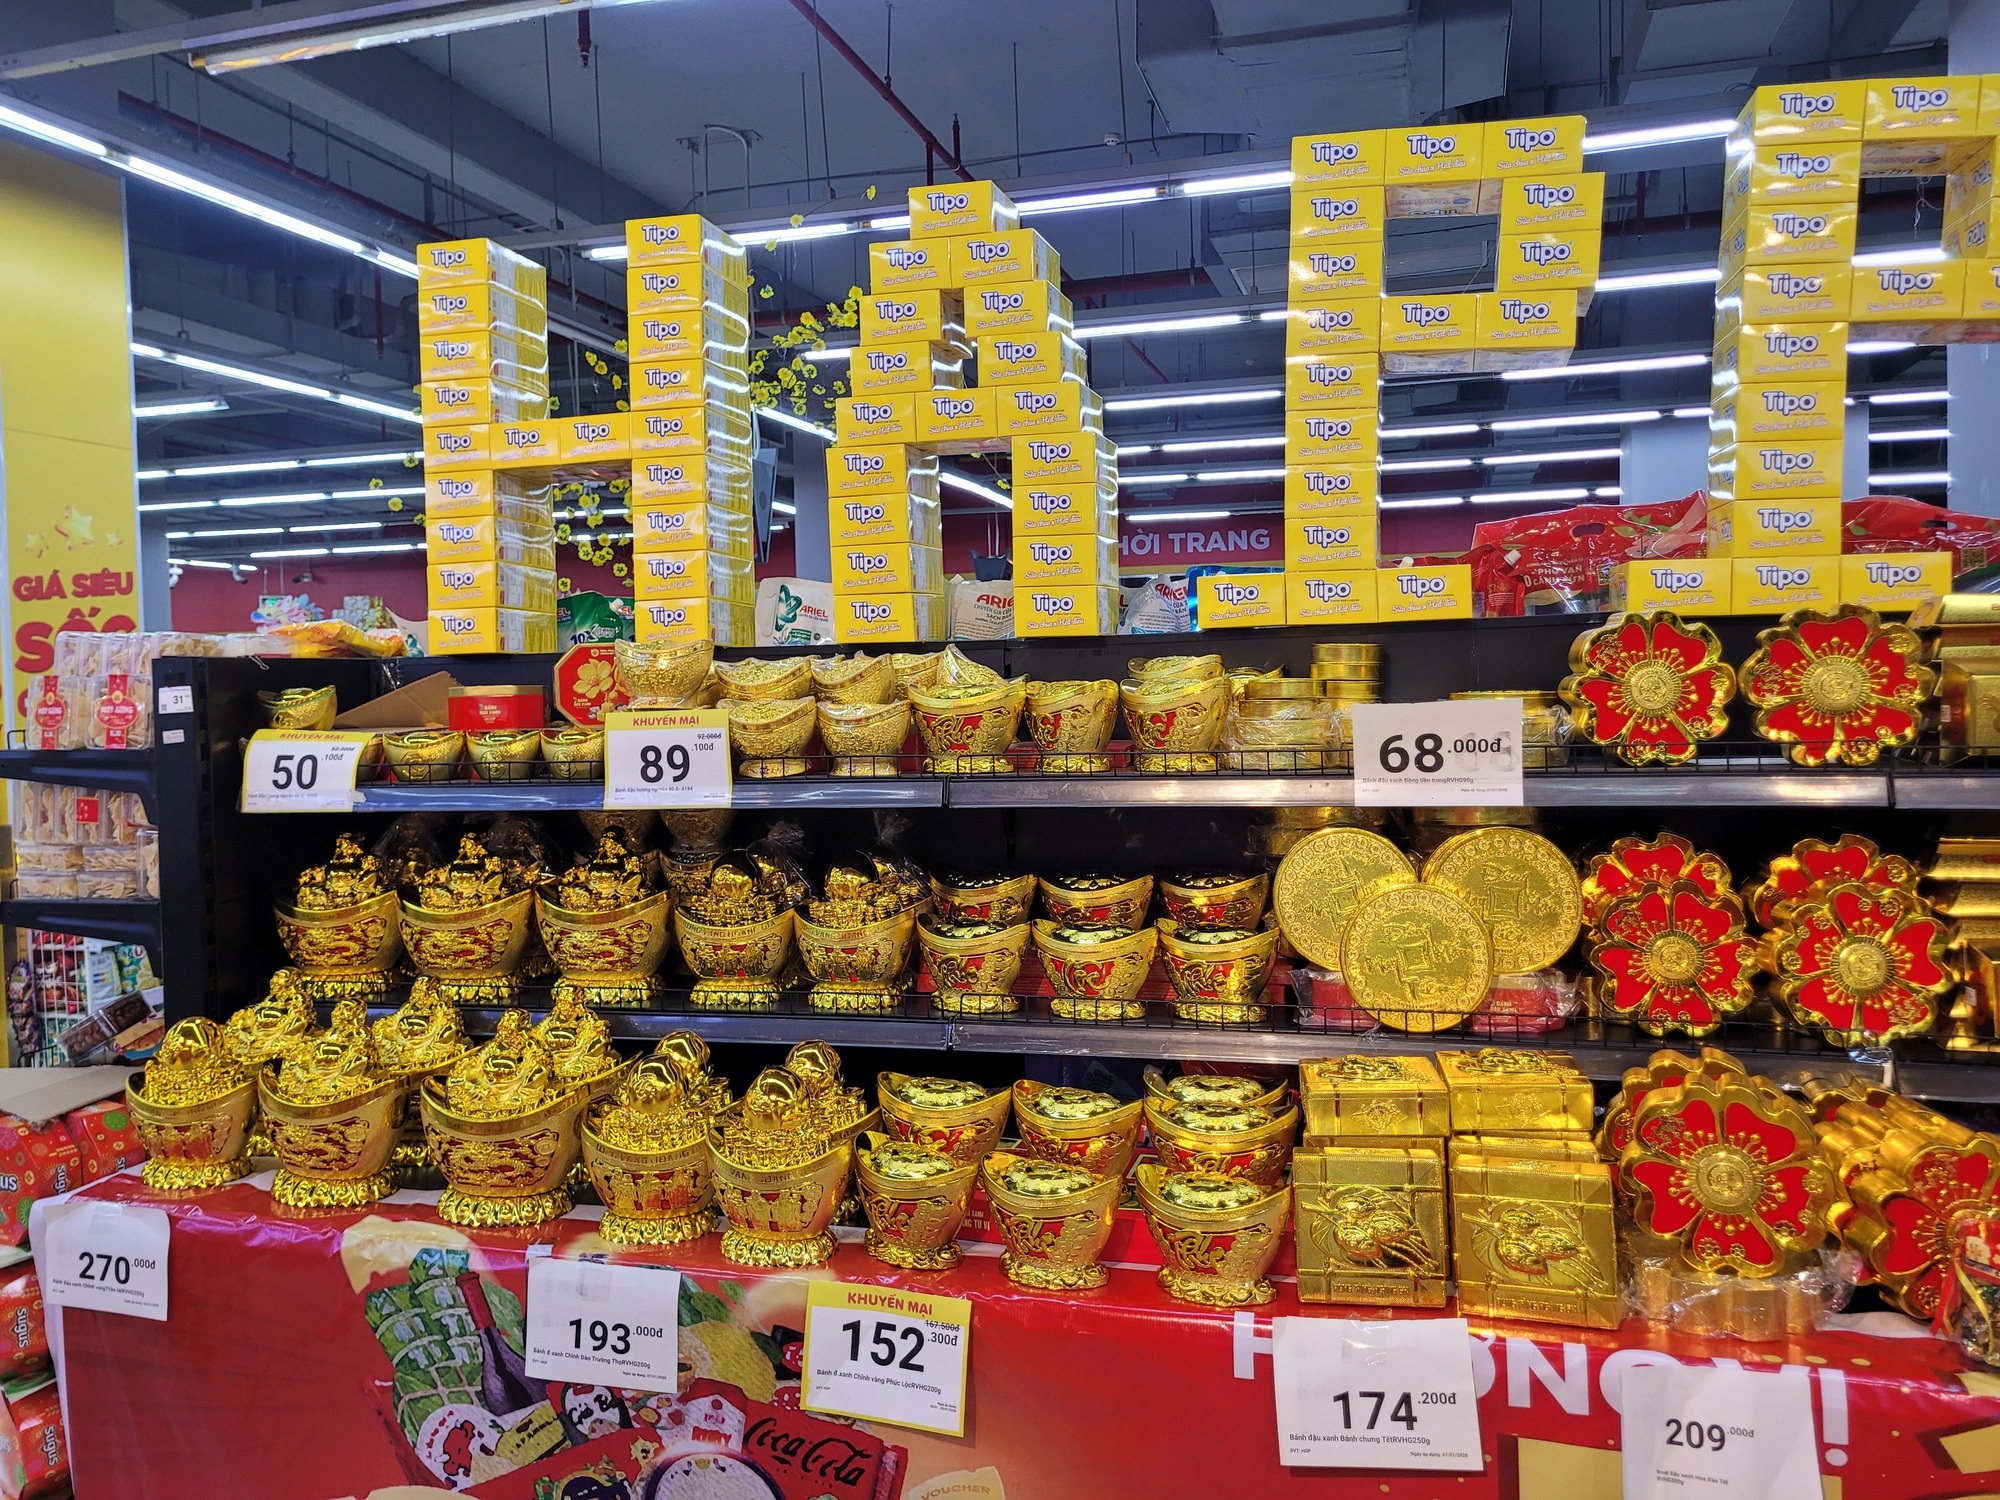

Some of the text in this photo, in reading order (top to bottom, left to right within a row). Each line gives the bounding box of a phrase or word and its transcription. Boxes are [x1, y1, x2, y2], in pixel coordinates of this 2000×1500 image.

[1779, 93, 1835, 118] Tipo
[1892, 86, 1949, 112] Tipo
[1407, 134, 1456, 158] Tipo
[1505, 128, 1557, 152] Tipo
[1310, 142, 1359, 166] Tipo
[1776, 153, 1831, 178] Tipo
[927, 192, 969, 214] Tipo
[1524, 184, 1575, 208] Tipo
[1310, 197, 1358, 221] Tipo
[642, 225, 679, 245] Tipo
[1772, 213, 1828, 239] Tipo
[431, 247, 467, 268] Tipo
[887, 248, 928, 269] Tipo
[967, 240, 1010, 262] Tipo
[1520, 242, 1571, 266] Tipo
[1309, 253, 1356, 277] Tipo
[642, 273, 679, 294] Tipo
[1768, 273, 1823, 299] Tipo
[1878, 269, 1934, 295] Tipo
[432, 293, 467, 314] Tipo
[876, 300, 917, 322] Tipo
[981, 291, 1023, 313] Tipo
[1500, 299, 1549, 323] Tipo
[1306, 309, 1354, 333] Tipo
[1402, 303, 1451, 327] Tipo
[643, 320, 680, 341] Tipo
[434, 340, 468, 360] Tipo
[995, 341, 1036, 363] Tipo
[1765, 332, 1819, 358] Tipo
[867, 352, 907, 373] Tipo
[645, 369, 682, 388] Tipo
[1305, 363, 1353, 387] Tipo
[435, 387, 469, 407] Tipo
[933, 397, 974, 419] Tipo
[1014, 391, 1056, 413] Tipo
[1762, 391, 1817, 416] Tipo
[853, 402, 892, 424] Tipo
[574, 422, 609, 442] Tipo
[645, 416, 683, 436] Tipo
[1304, 418, 1353, 441] Tipo
[437, 432, 472, 451] Tipo
[505, 428, 540, 447] Tipo
[1029, 442, 1071, 464] Tipo
[1759, 450, 1814, 475] Tipo
[646, 463, 684, 484] Tipo
[844, 454, 884, 476] Tipo
[438, 478, 473, 498] Tipo
[1303, 472, 1352, 495] Tipo
[845, 502, 885, 524] Tipo
[1029, 492, 1071, 514] Tipo
[647, 511, 685, 532] Tipo
[1758, 508, 1812, 534] Tipo
[439, 524, 474, 543] Tipo
[1168, 529, 1270, 553] TRANG
[1303, 525, 1351, 548] Tipo
[847, 551, 888, 572] Tipo
[1030, 543, 1072, 565] Tipo
[441, 570, 475, 589] Tipo
[648, 558, 686, 579] Tipo
[1756, 565, 1810, 590] Tipo
[1866, 562, 1922, 588] Tipo
[13, 568, 133, 601] GIÁ SIÊU
[1305, 579, 1352, 602] Tipo
[1397, 574, 1446, 599] Tipo
[1651, 568, 1703, 593] Tipo
[1032, 593, 1074, 614] Tipo
[1214, 583, 1259, 605] Tipo
[649, 606, 687, 627] Tipo
[800, 605, 828, 618] ARIEL
[850, 601, 891, 622] Tipo
[441, 615, 476, 635] Tipo
[173, 695, 183, 704] 31
[633, 714, 699, 727] KHUYẾN MẠI
[1379, 733, 1444, 773] 68
[1448, 738, 1502, 753] .000đ
[272, 755, 318, 790] 50
[640, 744, 690, 783] 89
[79, 1251, 131, 1285] 270
[847, 1292, 933, 1317] KHUYẾN MẠI
[13, 1306, 30, 1349] sugus
[569, 1318, 631, 1355] 193
[632, 1325, 663, 1338] .000đ
[842, 1319, 925, 1373] 152
[927, 1332, 958, 1347] .300đ
[1417, 1392, 1457, 1405] .200đ
[1333, 1391, 1418, 1431] 174
[42, 1425, 59, 1466] sugus
[1289, 1434, 1307, 1442] Bánh
[1308, 1434, 1322, 1443] đậu
[1340, 1435, 1358, 1443] Bánh
[1666, 1418, 1726, 1452] 209
[920, 1484, 990, 1500] VOUCHER
